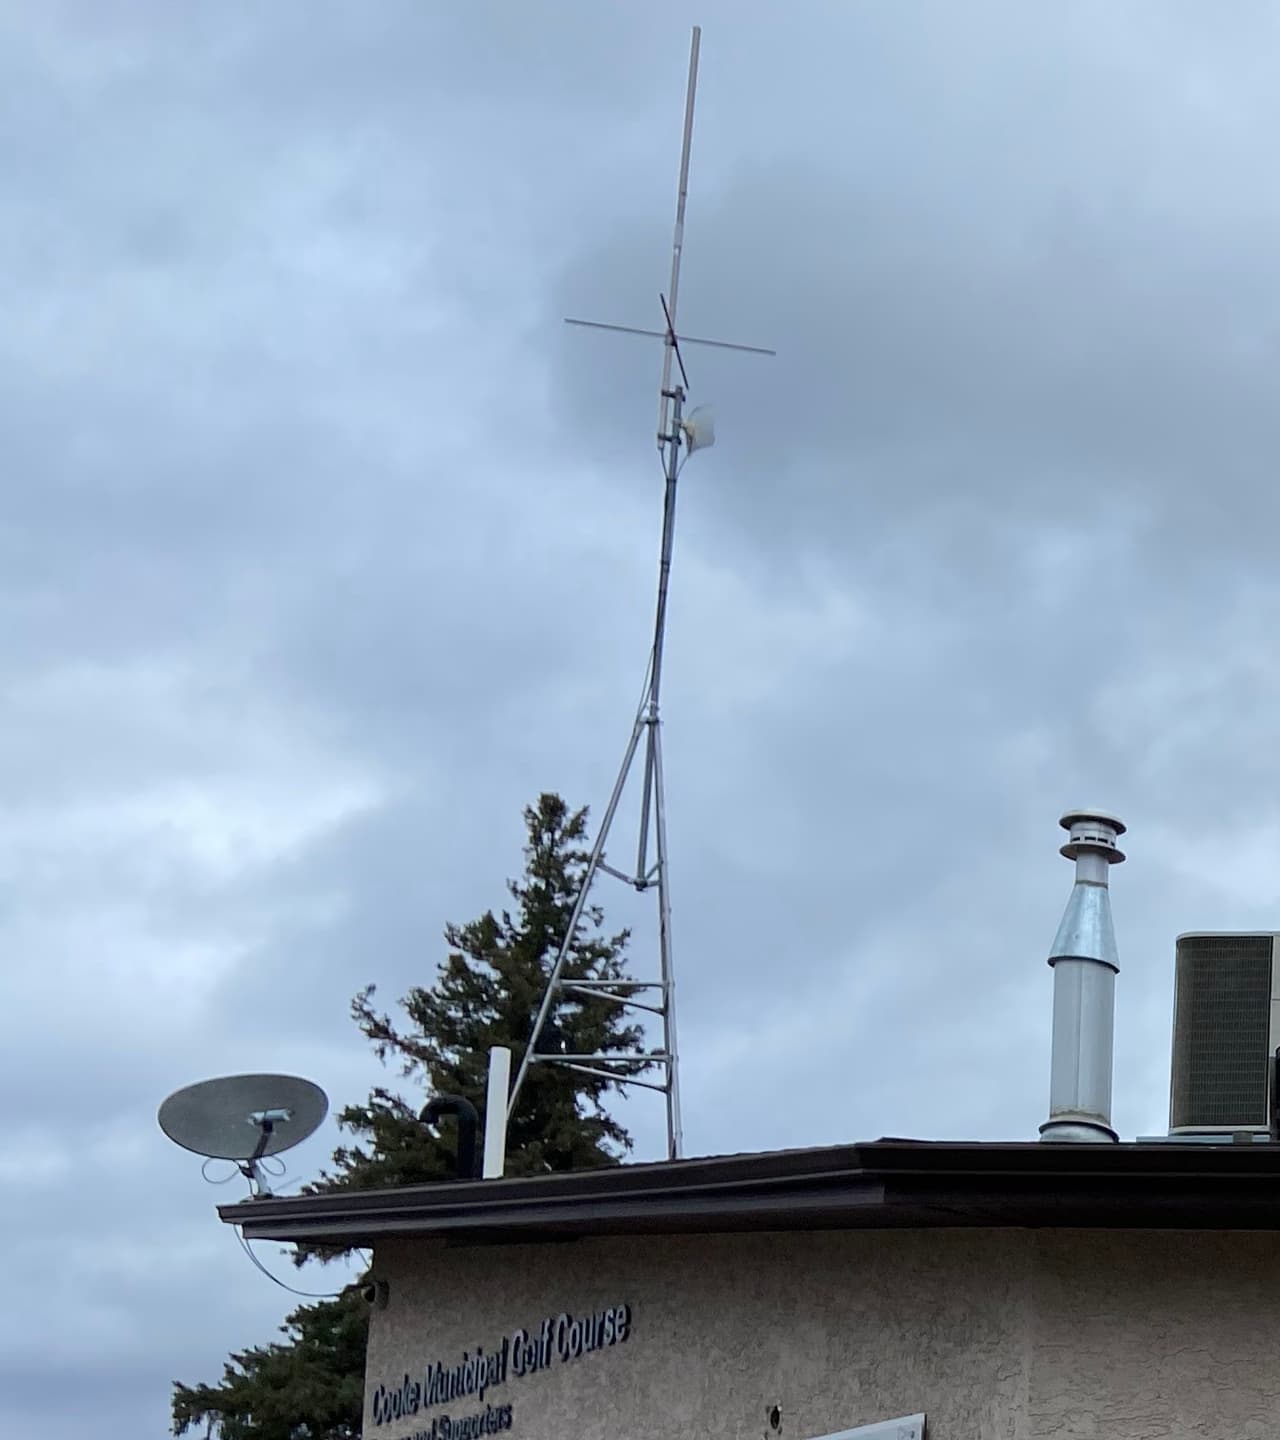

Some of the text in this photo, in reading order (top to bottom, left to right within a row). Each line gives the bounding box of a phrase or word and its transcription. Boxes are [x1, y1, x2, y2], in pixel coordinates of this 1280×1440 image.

[371, 1303, 632, 1426] Cooke Municipal Golf Course
